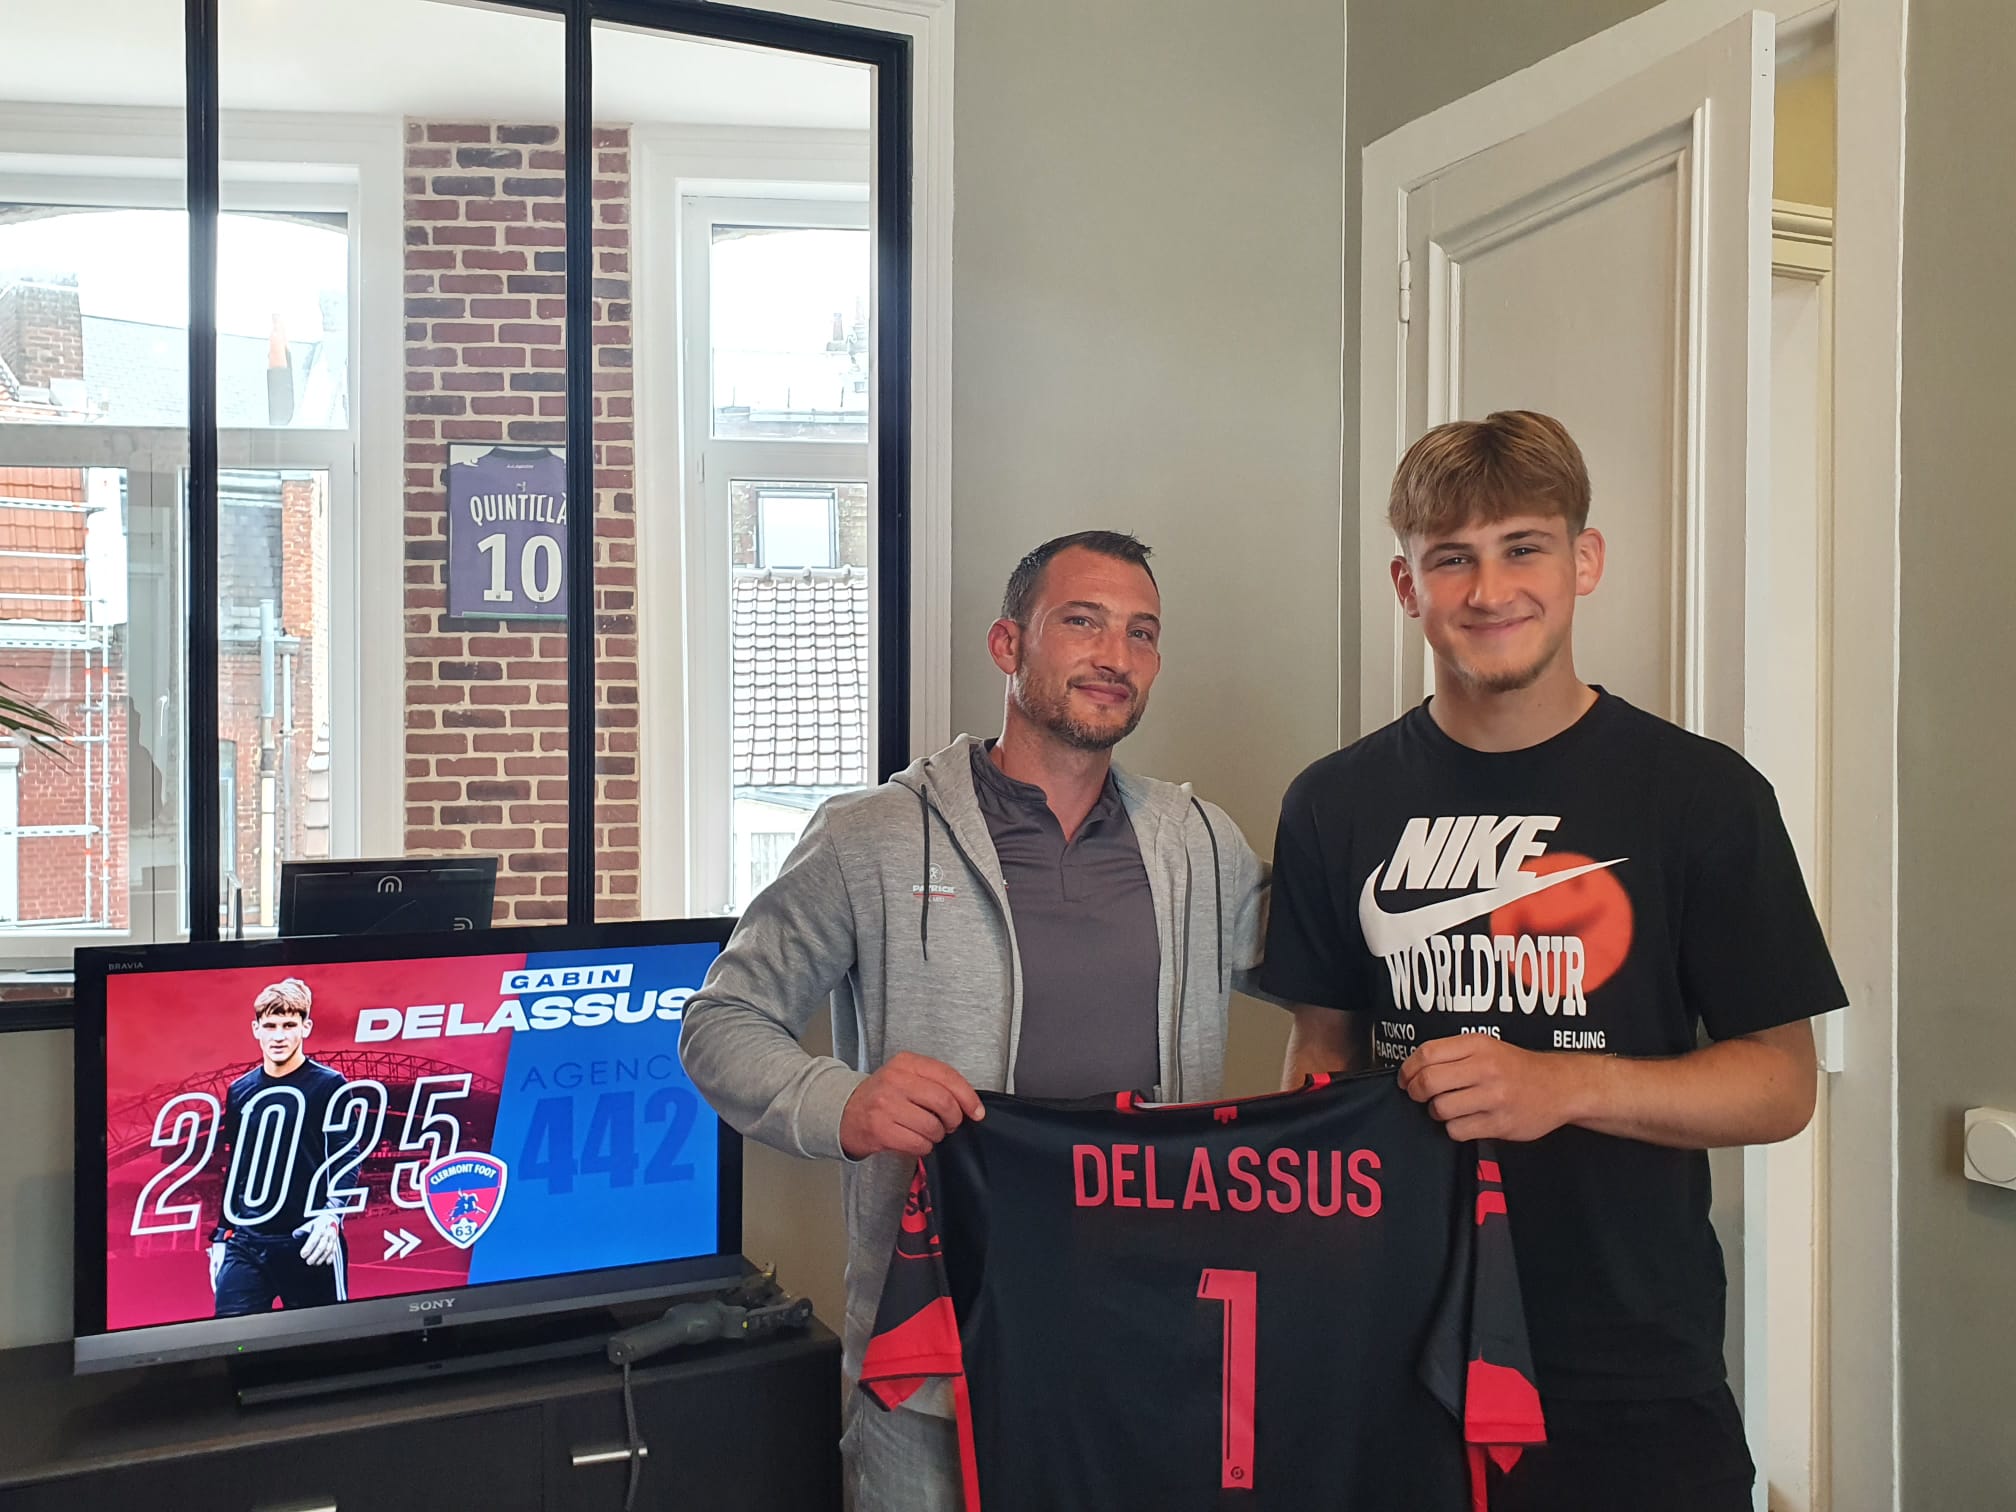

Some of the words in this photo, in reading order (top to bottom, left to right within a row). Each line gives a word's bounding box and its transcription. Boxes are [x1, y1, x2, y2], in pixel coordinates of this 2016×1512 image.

[477, 533, 562, 603] 10
[1380, 815, 1561, 891] NIKE
[912, 884, 956, 893] PARICK
[108, 962, 144, 971] BRAVIA
[510, 968, 621, 990] GABIN
[1384, 934, 1587, 1017] WORLDTOUR
[354, 987, 699, 1043] DELASSUS
[1381, 1020, 1415, 1041] TOKYO
[1553, 1029, 1606, 1049] BEIJING
[520, 1054, 688, 1092] AGENC
[130, 1072, 473, 1237] 2025
[517, 1085, 699, 1196] 442
[430, 1163, 474, 1185] CLERMONT
[474, 1164, 497, 1179] FOOT
[1072, 1143, 1384, 1218] DELASSUS
[455, 1225, 473, 1237] 63
[408, 1298, 456, 1313] SONY
[1196, 1268, 1257, 1490] 1
